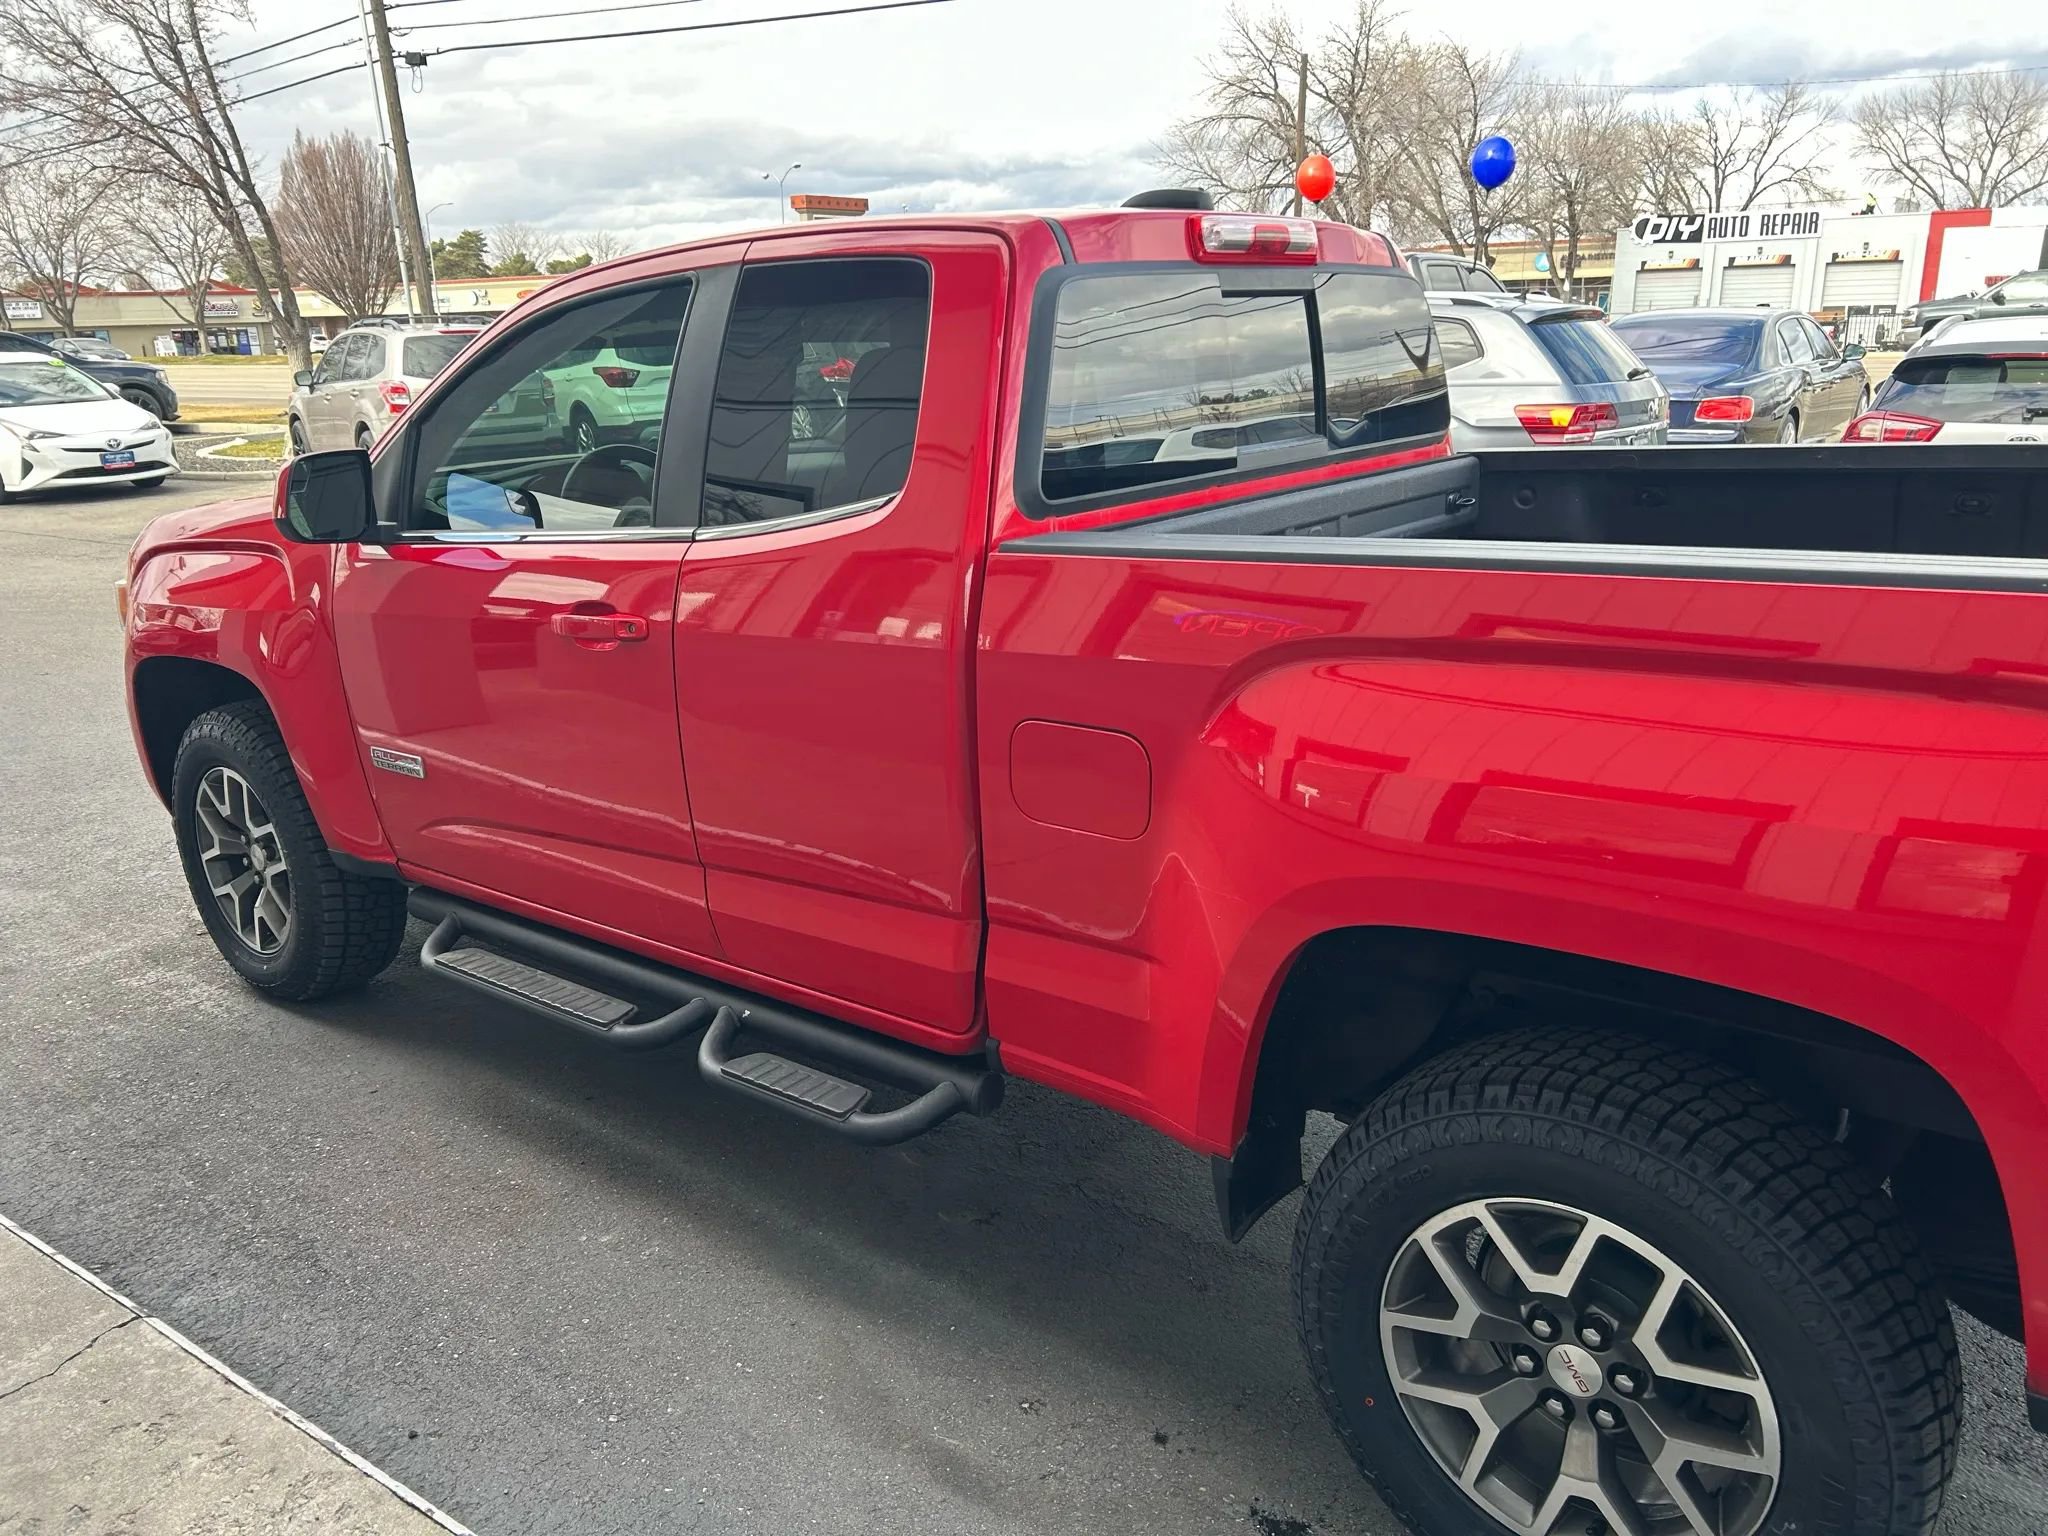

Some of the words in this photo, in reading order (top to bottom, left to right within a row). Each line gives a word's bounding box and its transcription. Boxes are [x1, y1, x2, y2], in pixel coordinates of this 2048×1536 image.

[1641, 215, 1703, 243] DIY
[1707, 215, 1750, 239] AUTO
[1759, 211, 1820, 236] REPAIR
[374, 750, 395, 762] ALL
[375, 759, 421, 776] TERRAIN
[1558, 1349, 1590, 1393] GMC
